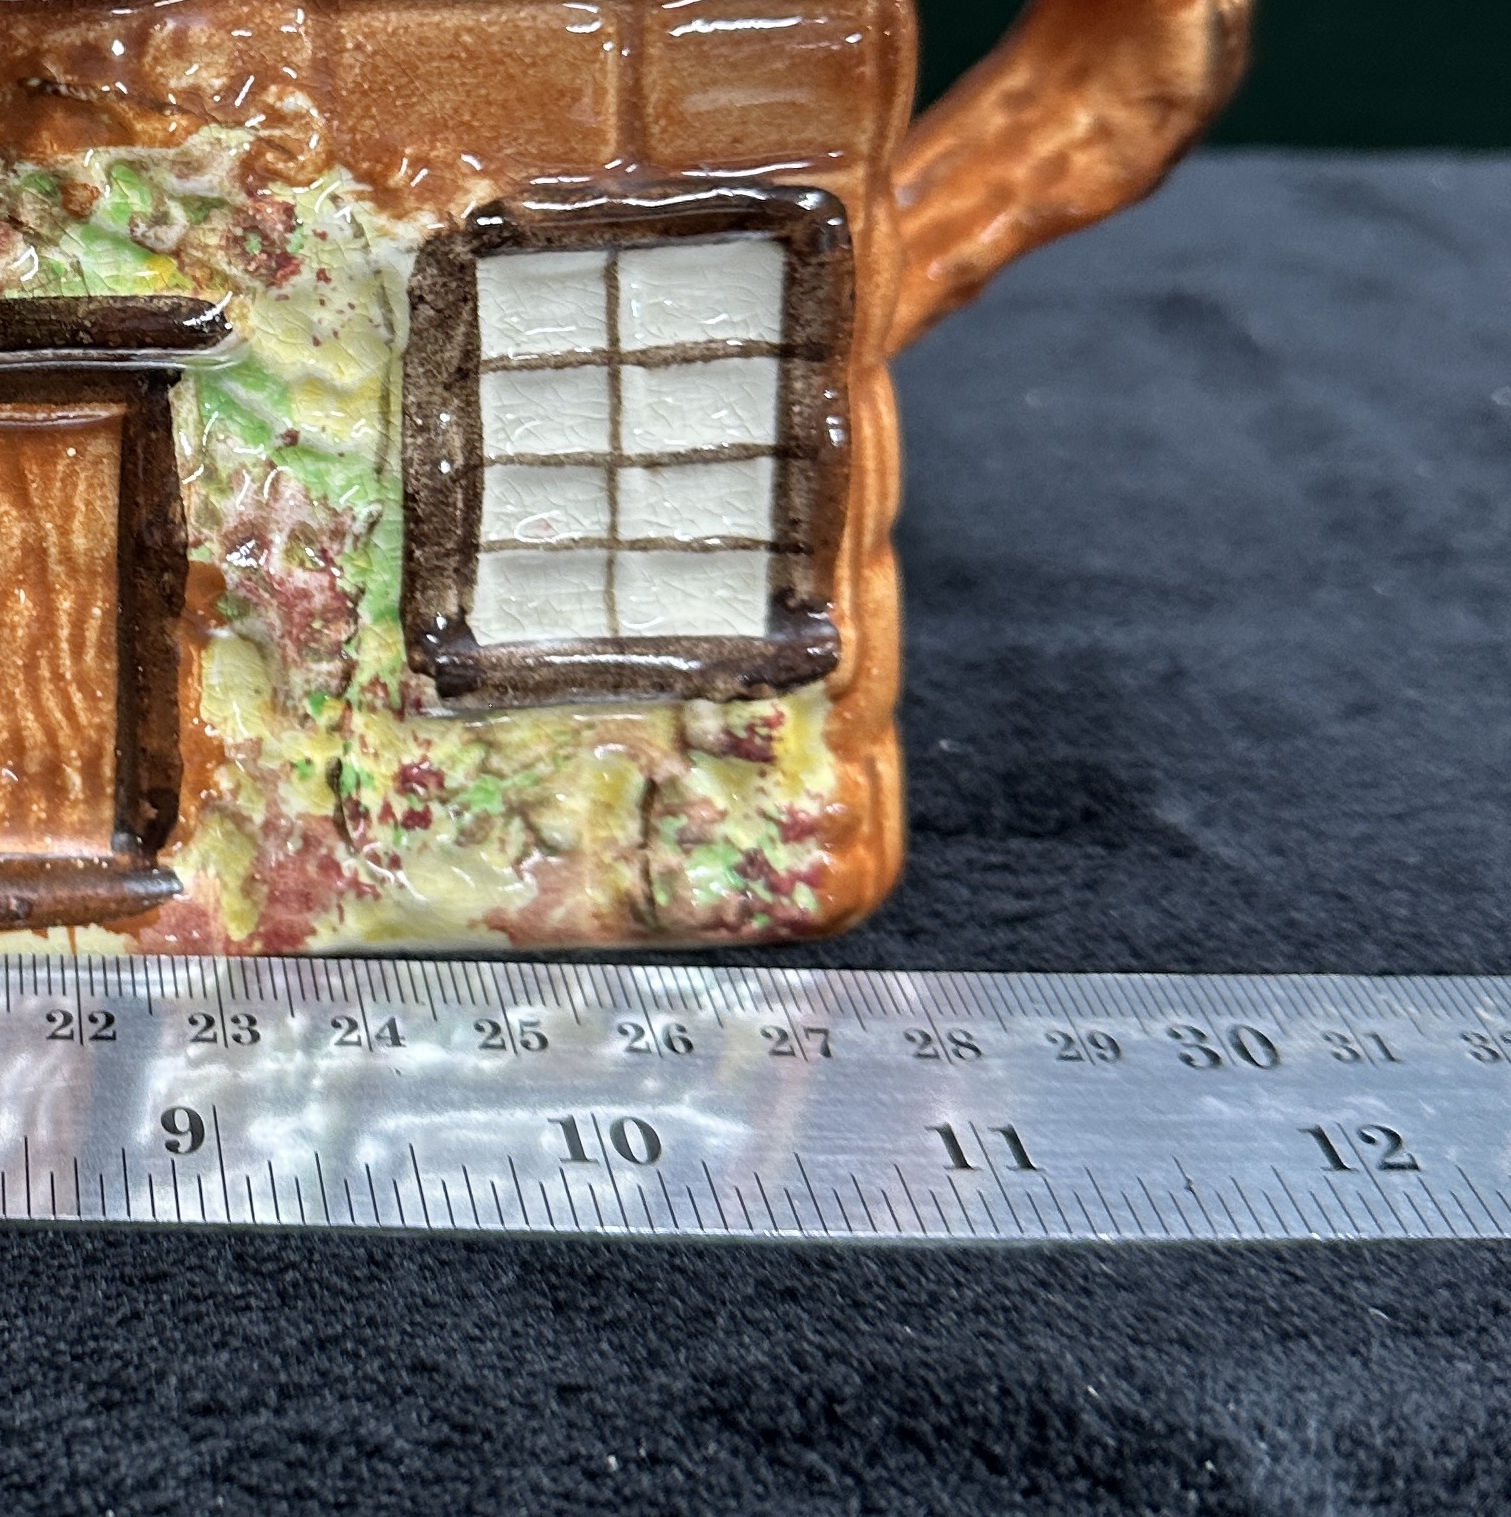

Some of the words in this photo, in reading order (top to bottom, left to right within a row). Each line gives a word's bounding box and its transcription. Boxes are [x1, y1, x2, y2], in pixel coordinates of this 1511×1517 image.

[46, 1009, 118, 1042] 22
[188, 1012, 261, 1045] 23
[330, 1015, 405, 1049] 24
[474, 1018, 548, 1053] 25
[617, 1022, 694, 1056] 26
[760, 1024, 833, 1058] 27
[904, 1027, 984, 1061] 28
[1046, 1029, 1121, 1064] 29
[1167, 1024, 1280, 1070] 30
[1321, 1030, 1402, 1065] 31
[1458, 1029, 1511, 1063] 3
[161, 1106, 205, 1155] 9
[547, 1114, 662, 1166] 10
[926, 1121, 1038, 1171] 11
[1298, 1123, 1421, 1172] 12
